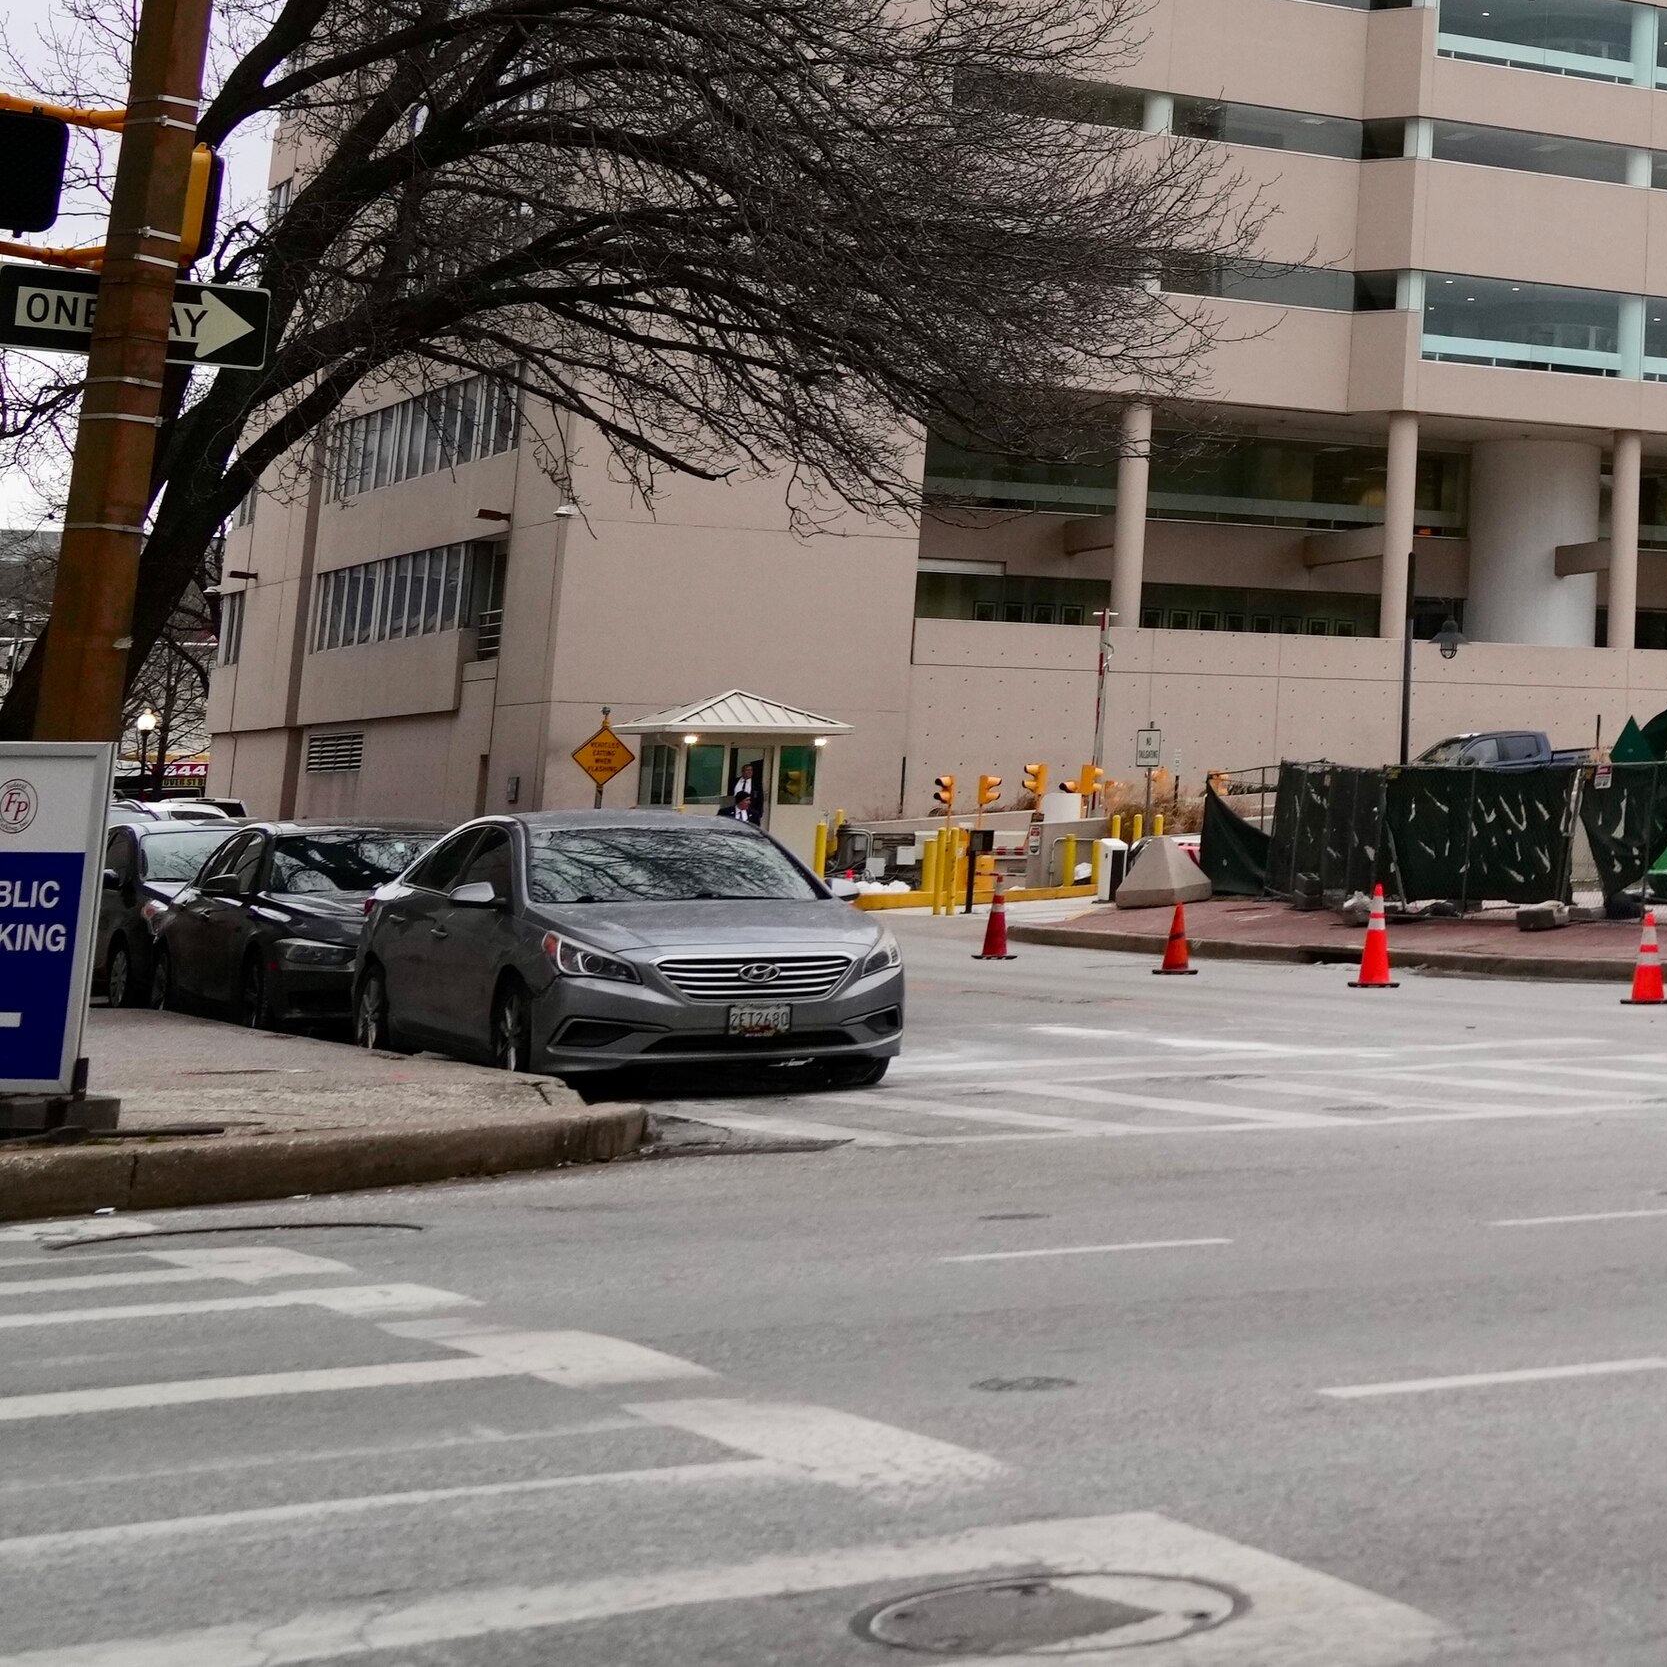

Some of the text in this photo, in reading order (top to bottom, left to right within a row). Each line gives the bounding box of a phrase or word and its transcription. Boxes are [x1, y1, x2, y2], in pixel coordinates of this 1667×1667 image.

[26, 293, 208, 338] ONE AY
[0, 880, 60, 909] BLIC
[0, 923, 67, 953] KING
